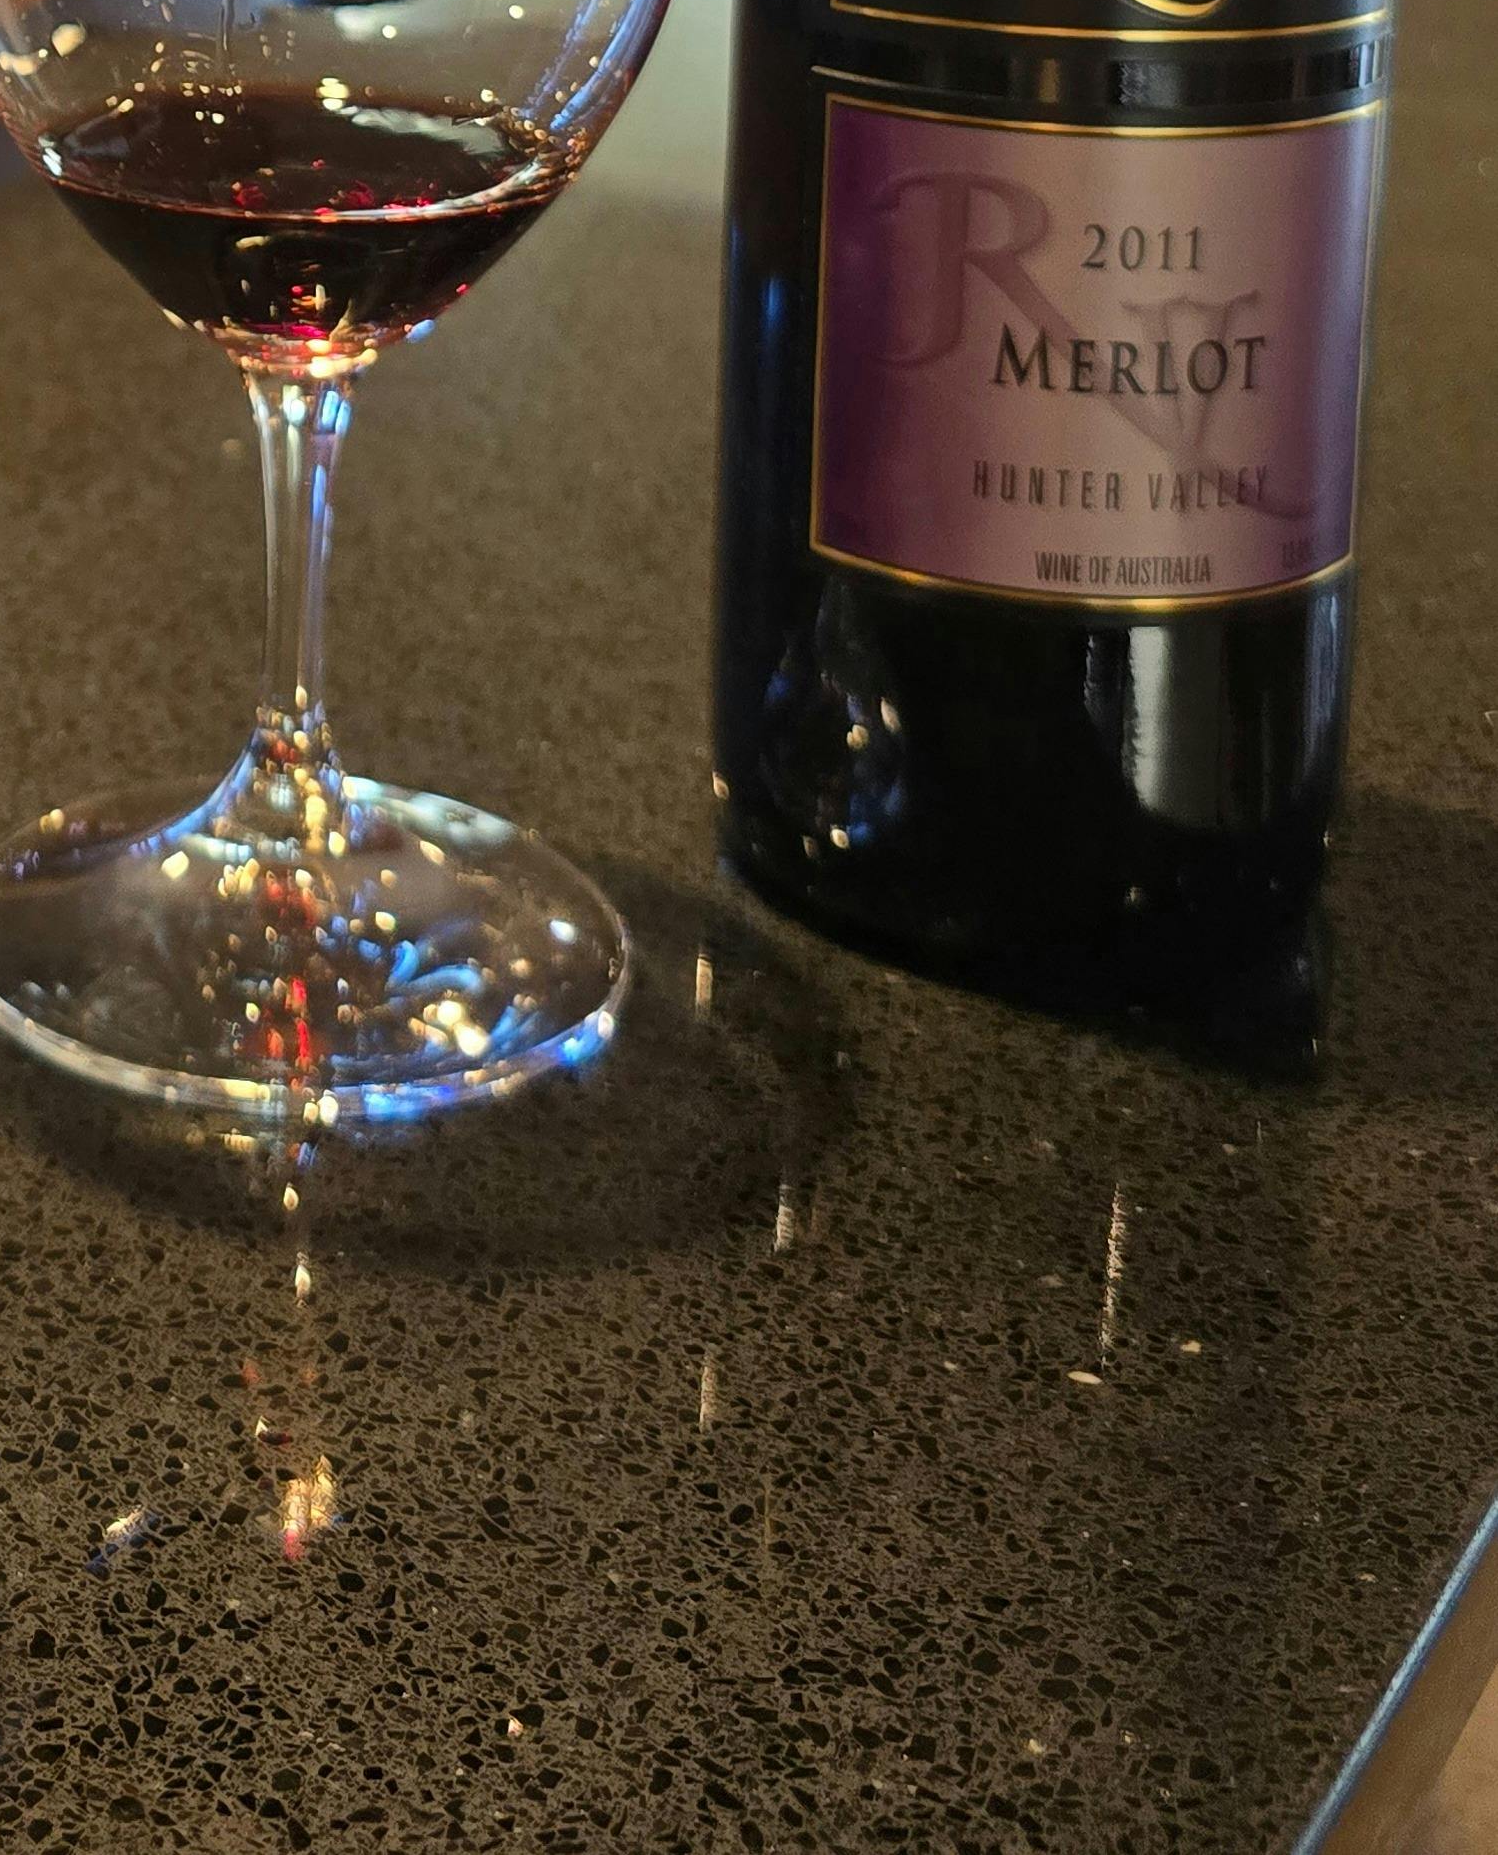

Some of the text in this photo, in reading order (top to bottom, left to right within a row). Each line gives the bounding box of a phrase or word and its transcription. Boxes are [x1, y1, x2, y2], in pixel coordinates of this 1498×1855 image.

[1081, 222, 1204, 272] 2011
[992, 325, 1267, 395] MERLOT
[973, 460, 1270, 513] HUNTER VALLEY
[1035, 551, 1211, 586] WINE OF AUSTRALIA
